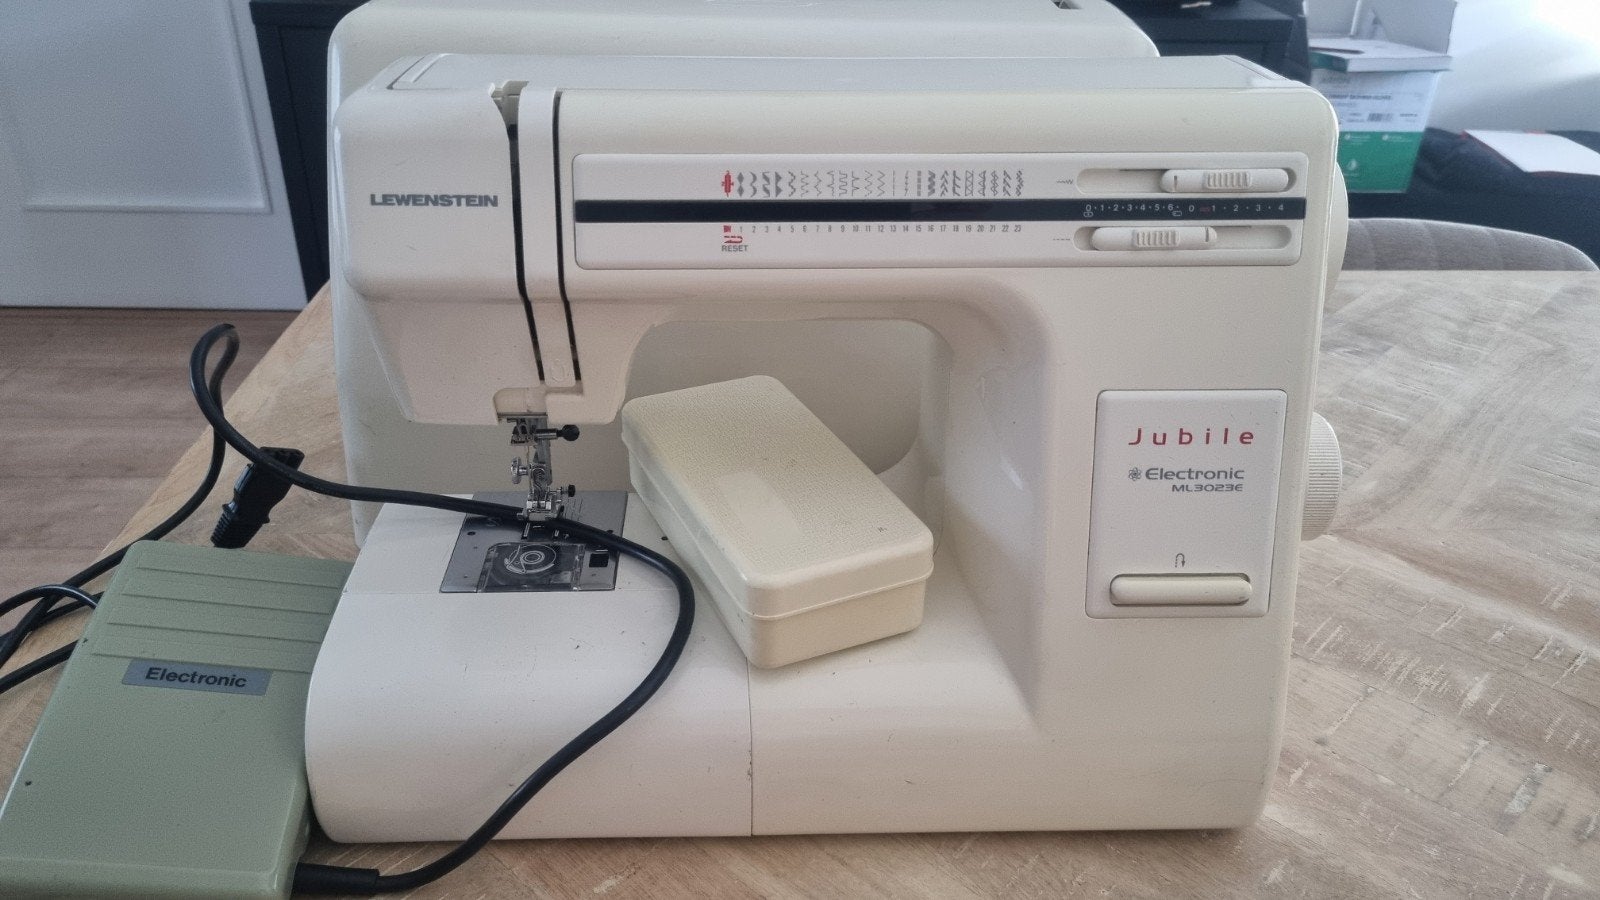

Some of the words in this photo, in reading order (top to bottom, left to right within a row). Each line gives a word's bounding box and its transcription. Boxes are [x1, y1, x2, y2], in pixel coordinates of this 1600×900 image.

[370, 193, 498, 208] LEWENSTEIN
[1085, 203, 1092, 212] 0
[1100, 203, 1104, 212] 1
[1113, 203, 1119, 212] 2
[1127, 203, 1133, 212] 3
[1140, 203, 1146, 212] 4
[1154, 203, 1160, 212] 5
[1167, 203, 1174, 212] 6
[1188, 204, 1195, 213] 0
[1211, 204, 1216, 212] 1
[1233, 204, 1239, 212] 2
[1255, 204, 1261, 212] 3
[1278, 204, 1284, 212] 4
[739, 225, 743, 234] 1
[752, 225, 757, 234] 2
[765, 225, 769, 234] 3
[777, 225, 782, 234] 4
[790, 224, 795, 233] 5
[803, 224, 808, 233] 6
[816, 224, 820, 233] 7
[828, 224, 833, 233] 8
[841, 224, 846, 233] 9
[853, 224, 859, 233] 10
[865, 224, 871, 233] 11
[878, 224, 885, 233] 12
[890, 224, 897, 233] 13
[903, 224, 909, 233] 14
[916, 224, 922, 233] 15
[928, 224, 935, 233] 16
[940, 224, 947, 233] 17
[953, 224, 960, 233] 18
[966, 224, 972, 233] 19
[977, 224, 985, 233] 20
[990, 224, 996, 233] 21
[1002, 224, 1009, 233] 22
[1014, 224, 1021, 233] 23
[721, 243, 749, 253] RESET
[1128, 427, 1254, 446] Jubile
[1145, 467, 1245, 480] Electronic
[1171, 484, 1243, 492] ML3023E
[145, 667, 247, 688] Electronic
